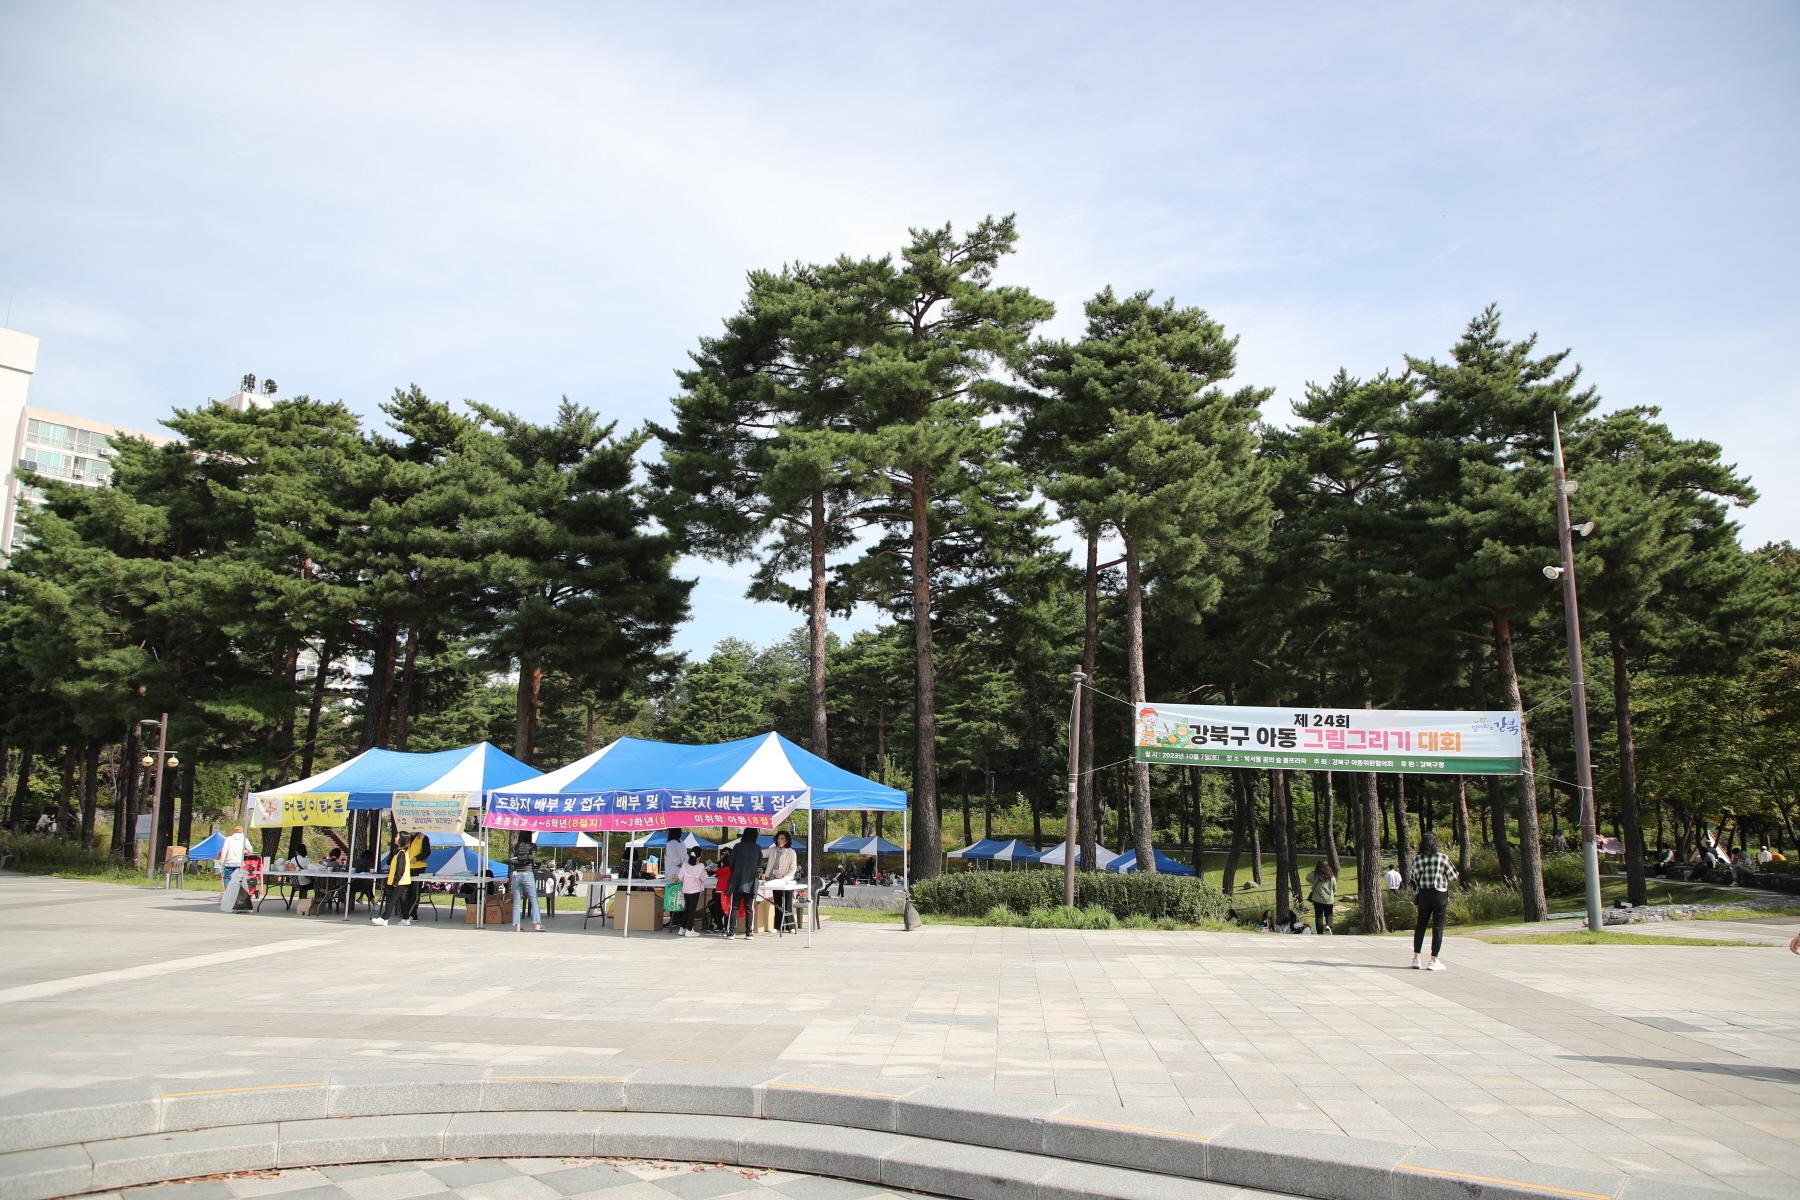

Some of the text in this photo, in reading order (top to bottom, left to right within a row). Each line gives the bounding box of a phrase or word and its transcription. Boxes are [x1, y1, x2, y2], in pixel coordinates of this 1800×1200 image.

[1294, 713, 1350, 728] 제 24회
[1494, 716, 1519, 735] 강북
[1189, 725, 1462, 752] 강북구 아동 그림그리기 대회
[1162, 752, 1184, 760] 2023년
[1201, 753, 1220, 761] 7일(토)
[1244, 755, 1262, 763] 북서울
[1332, 758, 1350, 766] 강북구
[1420, 761, 1445, 769] 강북구청
[495, 795, 607, 812] 도화지 배부 및 접수
[616, 793, 659, 811] 배부 및
[670, 794, 711, 810] 도화지
[716, 795, 745, 811] 배부
[750, 795, 765, 811] 및
[493, 815, 528, 827] 초등학교
[694, 813, 724, 824] 미취학
